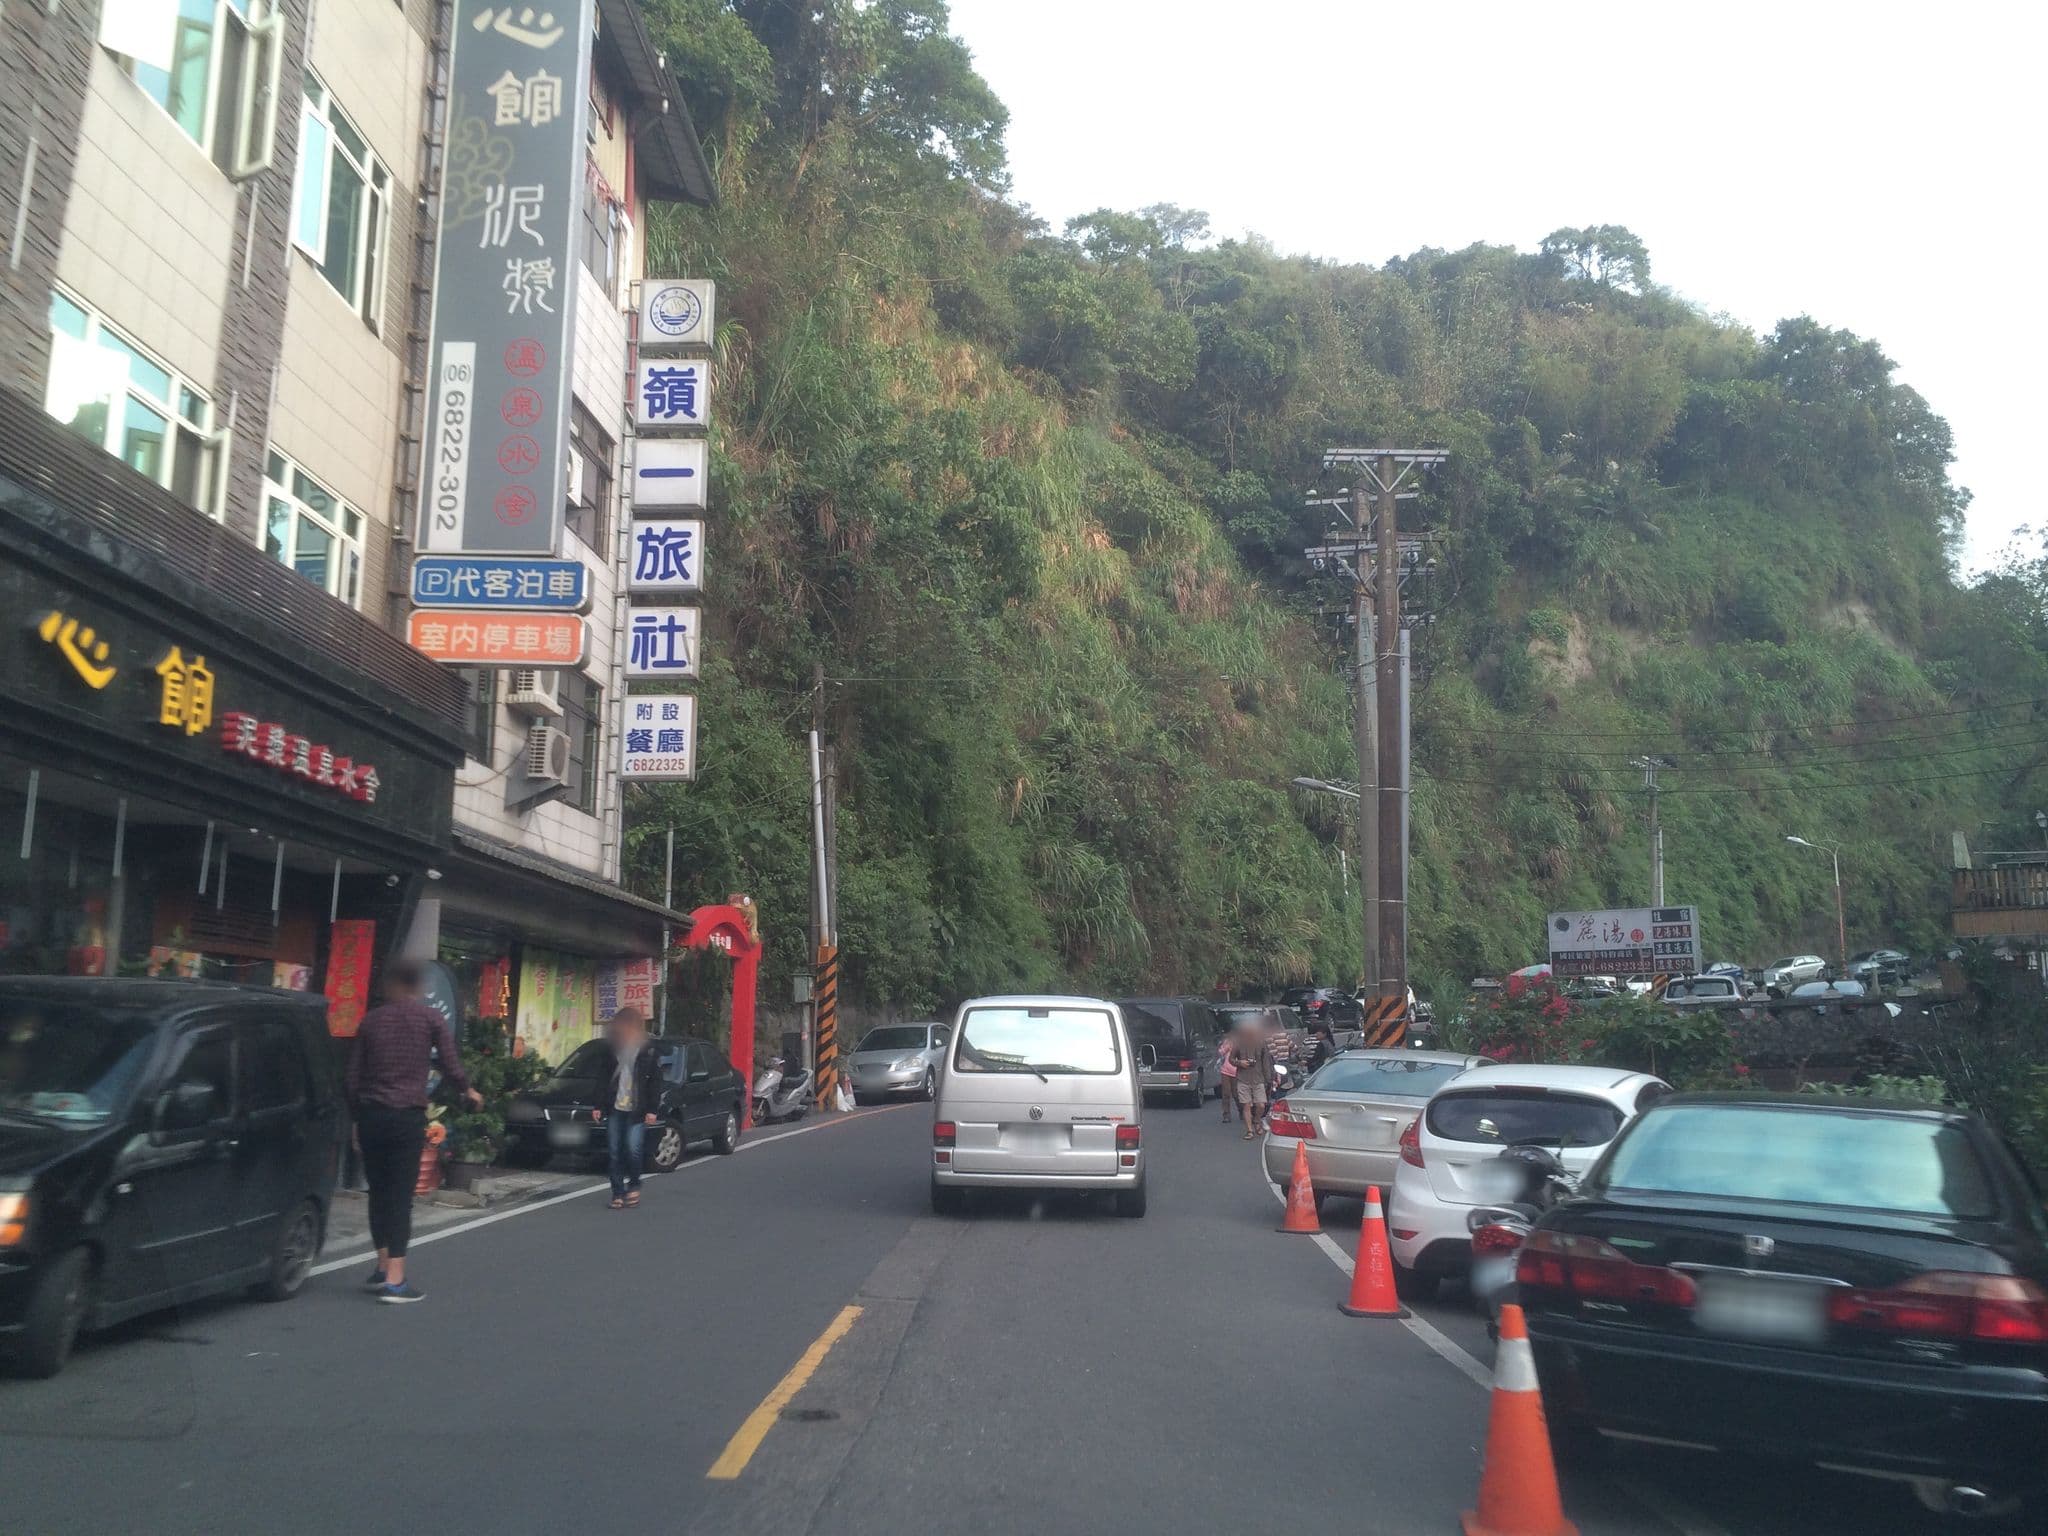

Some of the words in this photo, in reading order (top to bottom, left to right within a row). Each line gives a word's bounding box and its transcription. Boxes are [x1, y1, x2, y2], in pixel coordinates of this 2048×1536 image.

[472, 7, 564, 127] 心館
[435, 390, 467, 531] 6822-302
[631, 367, 697, 670] 嶺一旅社
[452, 568, 577, 599] 代客泊車
[418, 624, 573, 656] 室內停車場
[38, 611, 216, 737] 心館
[636, 703, 679, 721] 附設
[626, 728, 685, 754] 餐廳
[633, 758, 685, 772] 6822325
